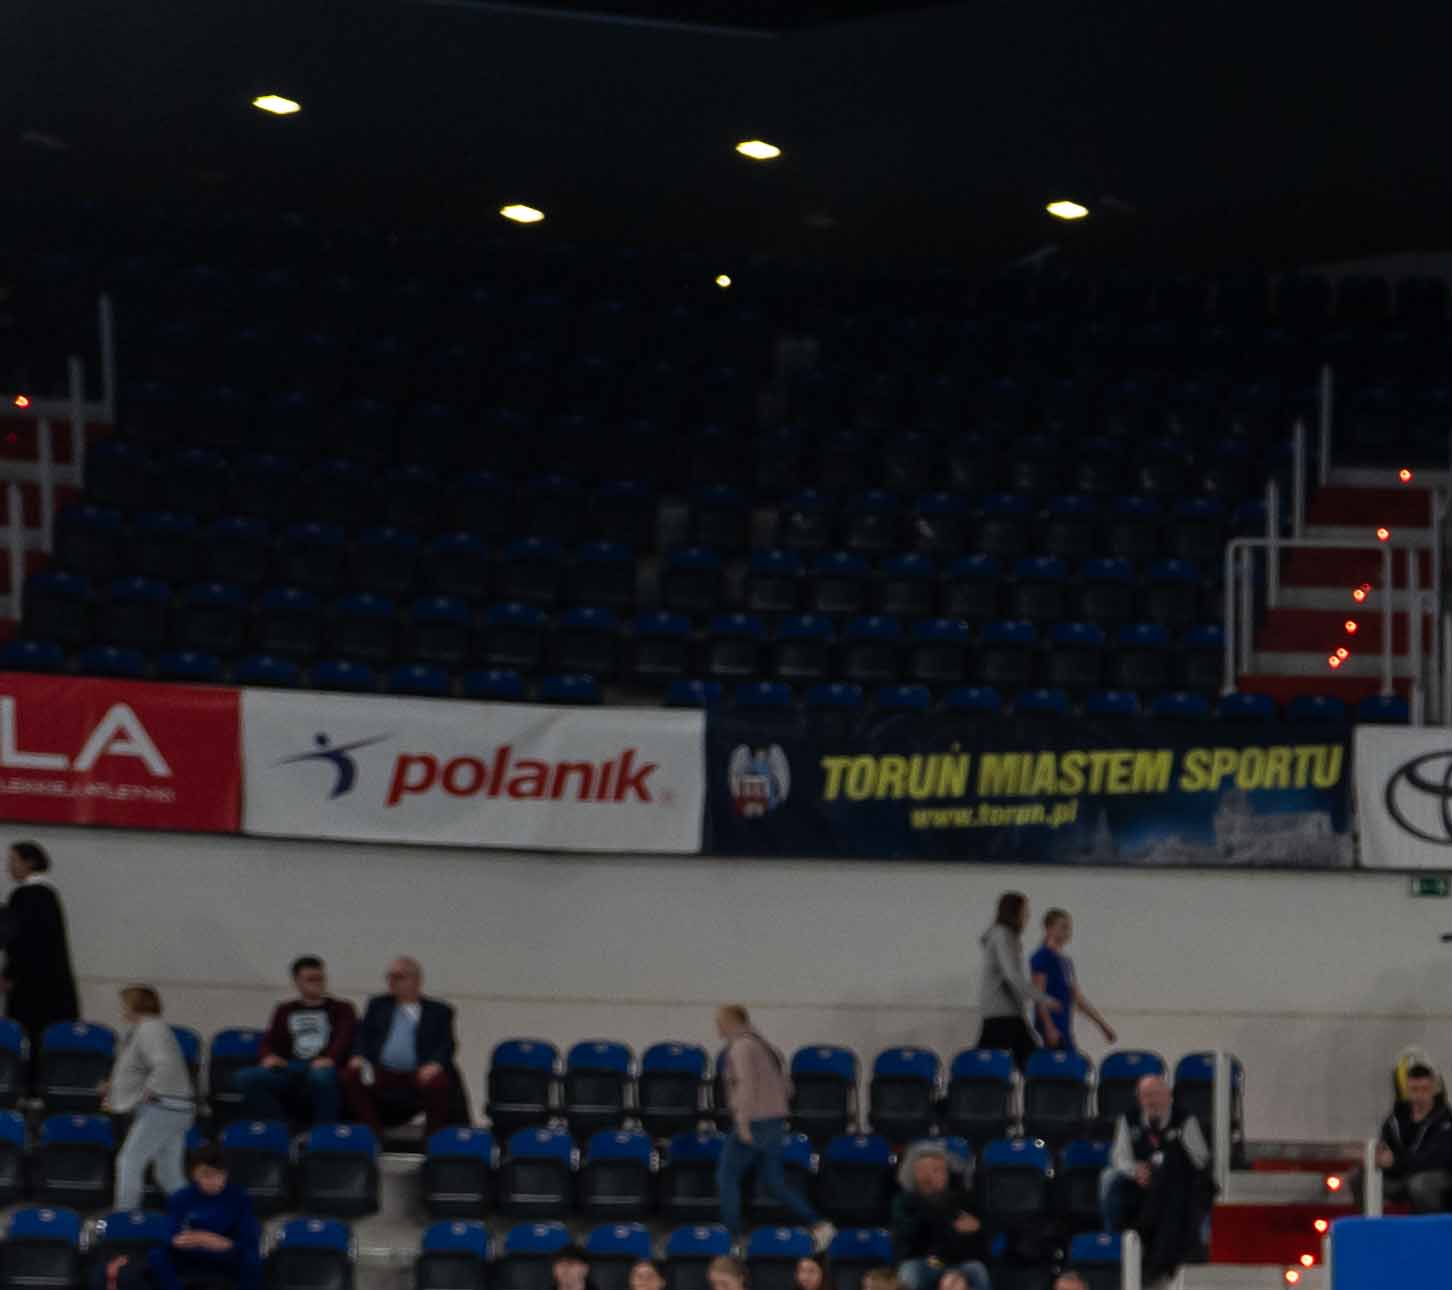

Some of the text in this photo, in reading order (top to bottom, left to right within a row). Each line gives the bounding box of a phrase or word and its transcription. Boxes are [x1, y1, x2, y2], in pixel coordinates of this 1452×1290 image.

[0, 697, 172, 776] LA
[386, 747, 657, 806] polanik
[821, 742, 1342, 799] TORUŃ MIASTEM SPORTU
[910, 800, 1078, 829] www.torun.pl
